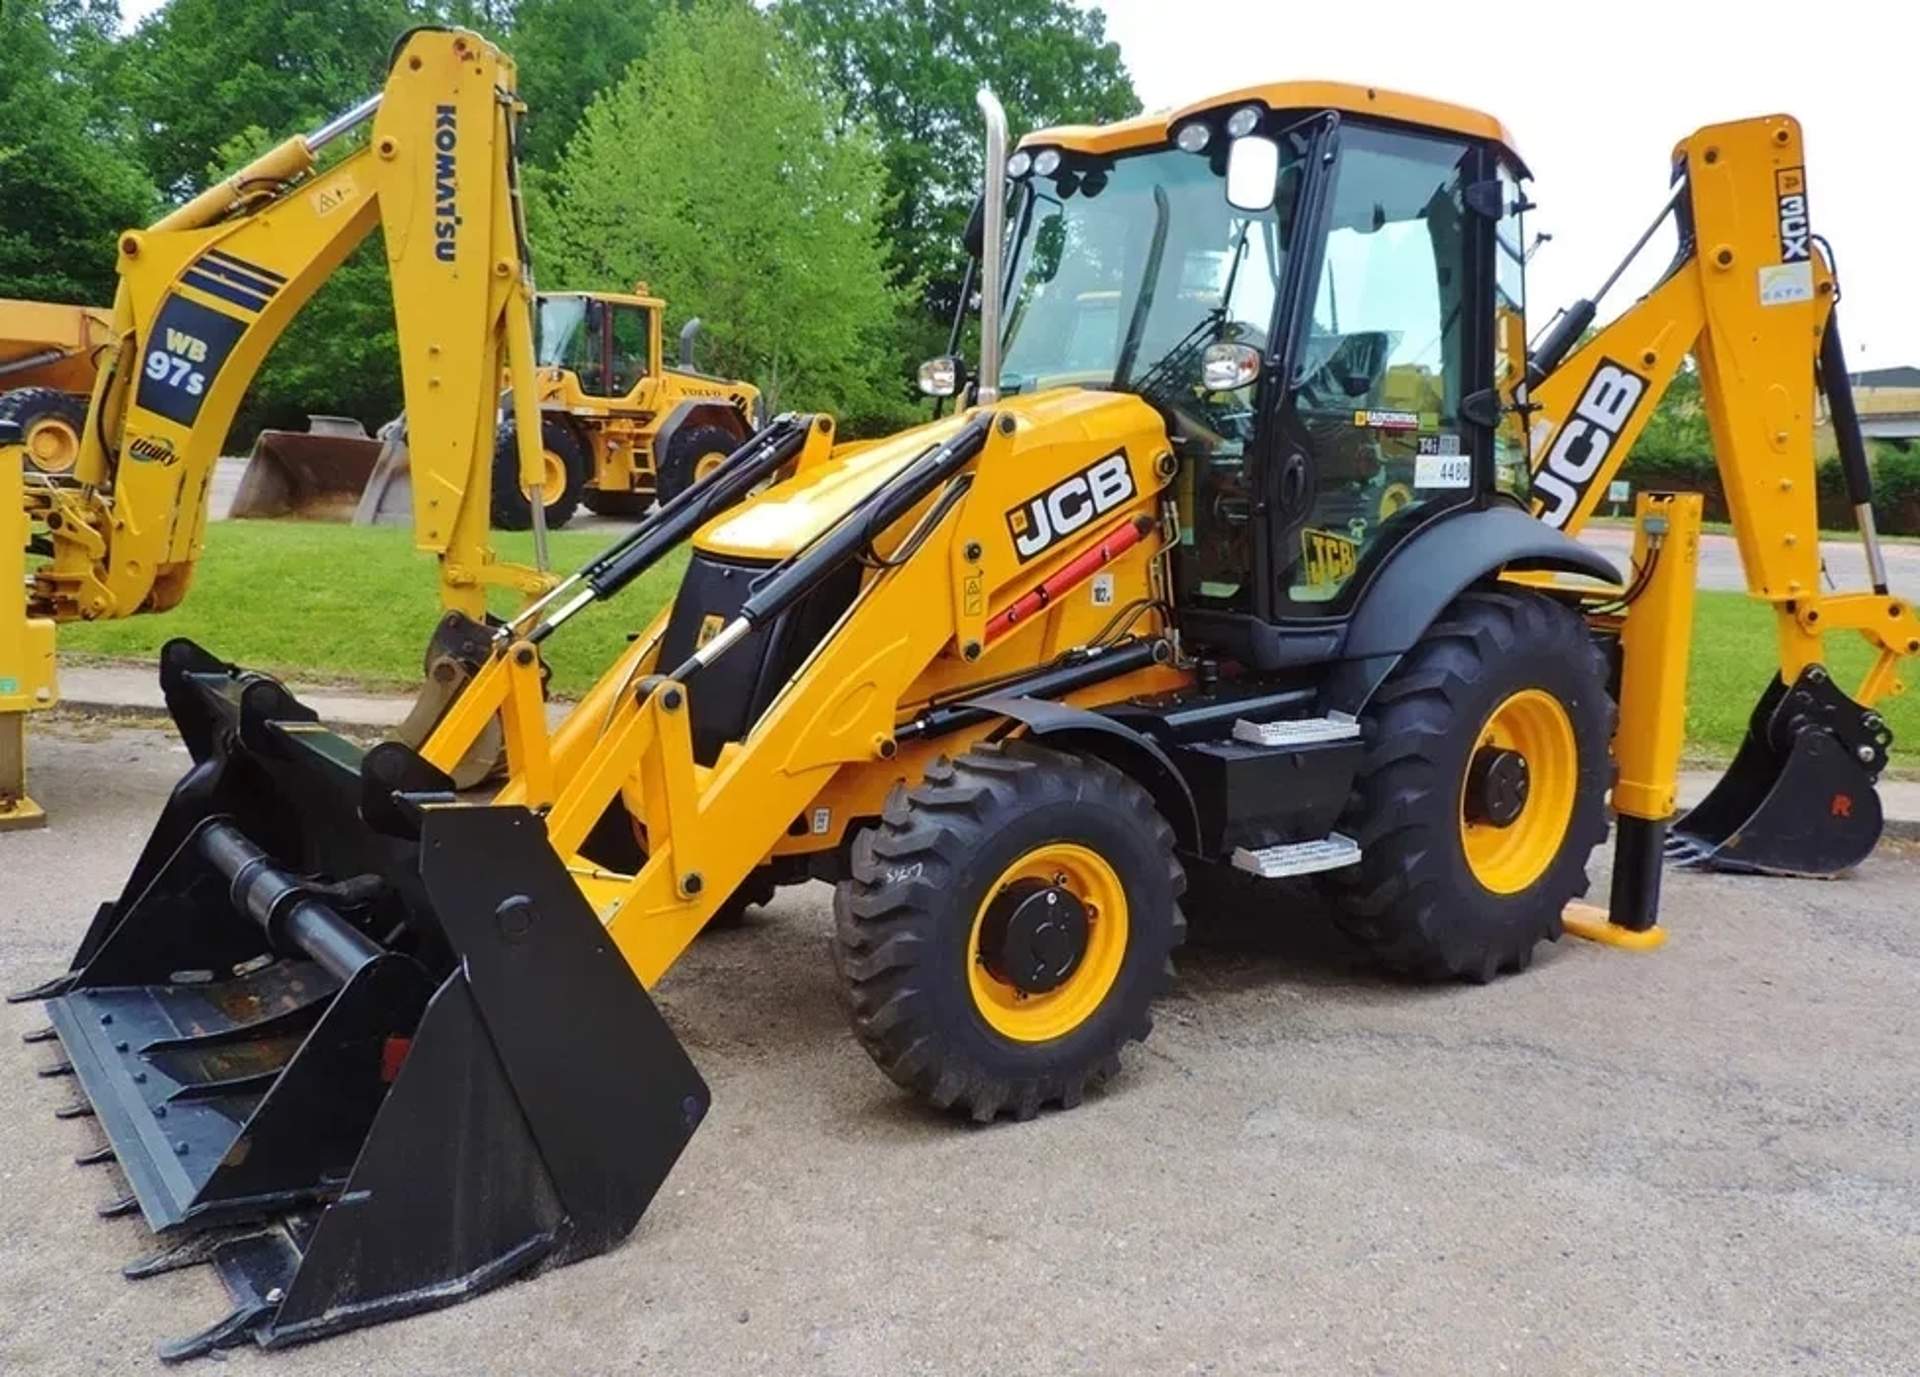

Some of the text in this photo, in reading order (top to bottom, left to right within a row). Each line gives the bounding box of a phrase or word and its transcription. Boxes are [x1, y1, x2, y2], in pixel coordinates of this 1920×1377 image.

[435, 105, 456, 262] KOMATSU
[1780, 195, 1808, 260] 3CX
[166, 327, 208, 363] WB
[130, 438, 180, 467] Utility
[1534, 365, 1643, 528] JCB
[1016, 454, 1133, 556] JCB
[1310, 535, 1352, 584] JCB
[1831, 794, 1851, 817] R
